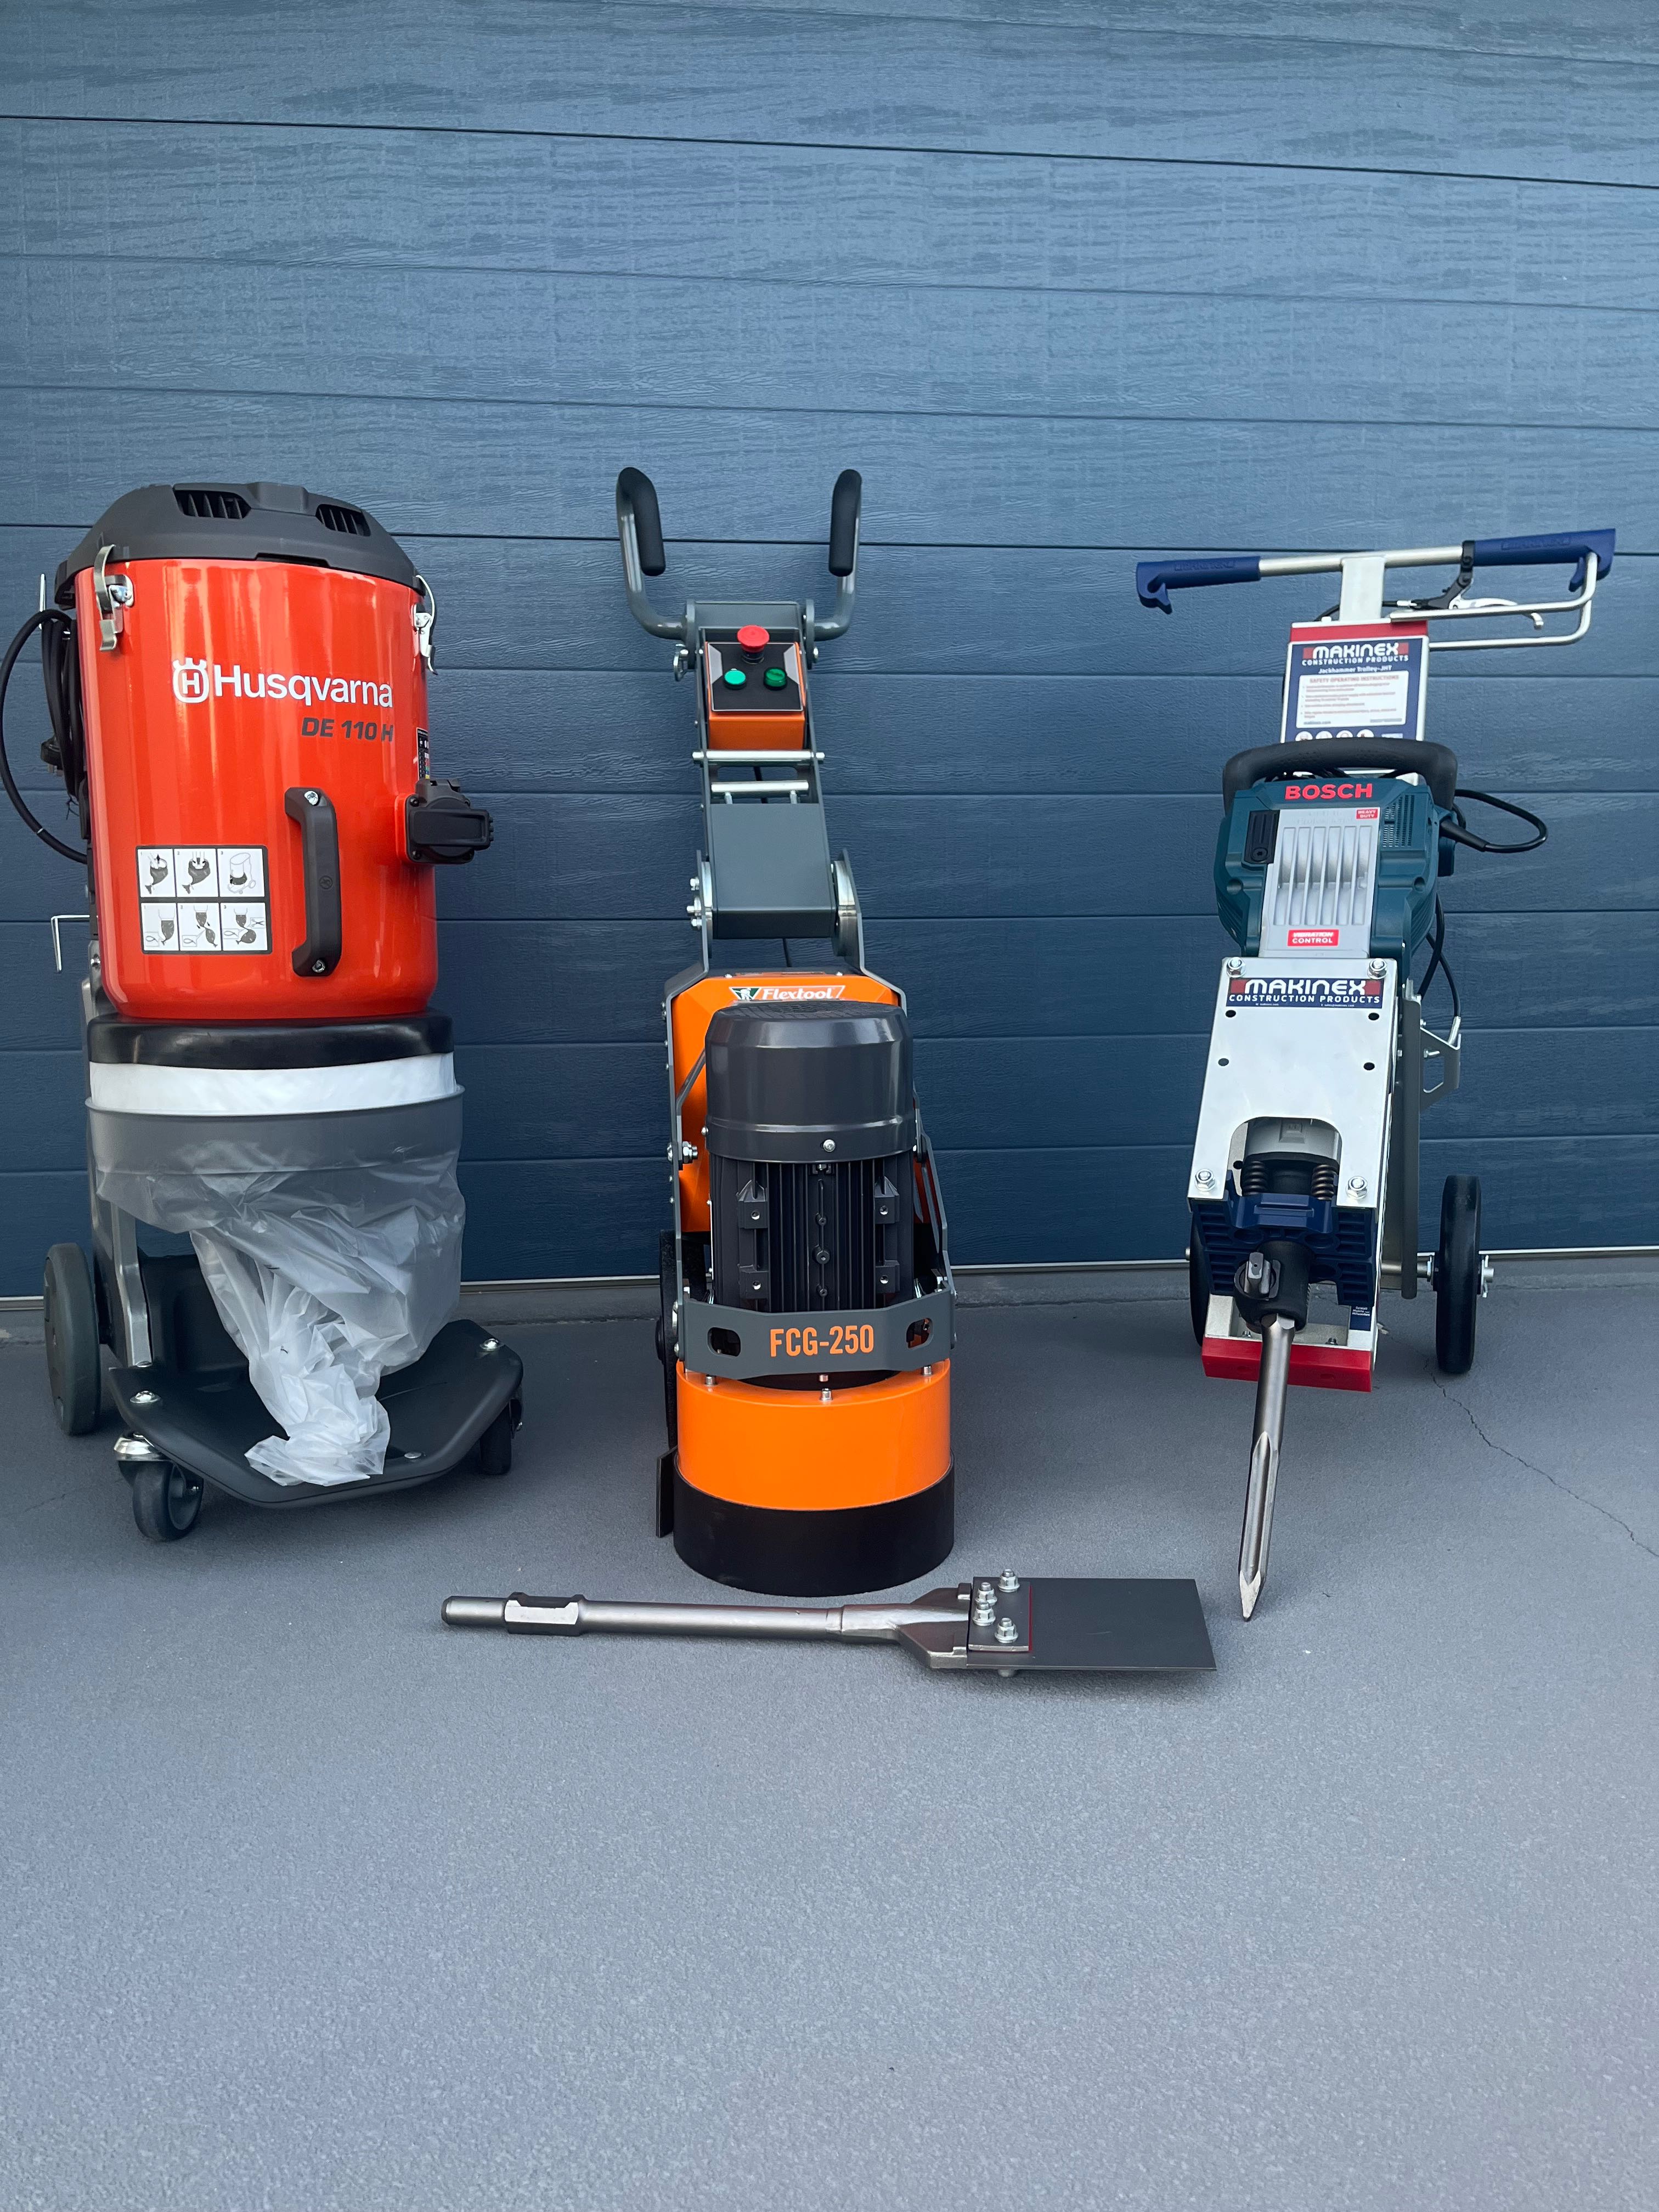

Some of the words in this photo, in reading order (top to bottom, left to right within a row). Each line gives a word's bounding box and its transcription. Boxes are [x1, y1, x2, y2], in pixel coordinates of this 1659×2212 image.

[1312, 642, 1399, 659] MAKINEX
[1302, 658, 1363, 666] CONSTRUCTION
[1366, 655, 1409, 663] PRODUCTS
[213, 665, 393, 708] Husqvarna
[301, 718, 334, 737] DE
[341, 720, 377, 741] 110
[381, 724, 393, 742] H
[1285, 783, 1372, 800] BOSCH
[762, 988, 833, 1000] Flextool
[1245, 979, 1366, 995] MAKINEX
[1229, 994, 1315, 1002] CONSTRUCTION
[770, 1324, 874, 1358] FCG-250
